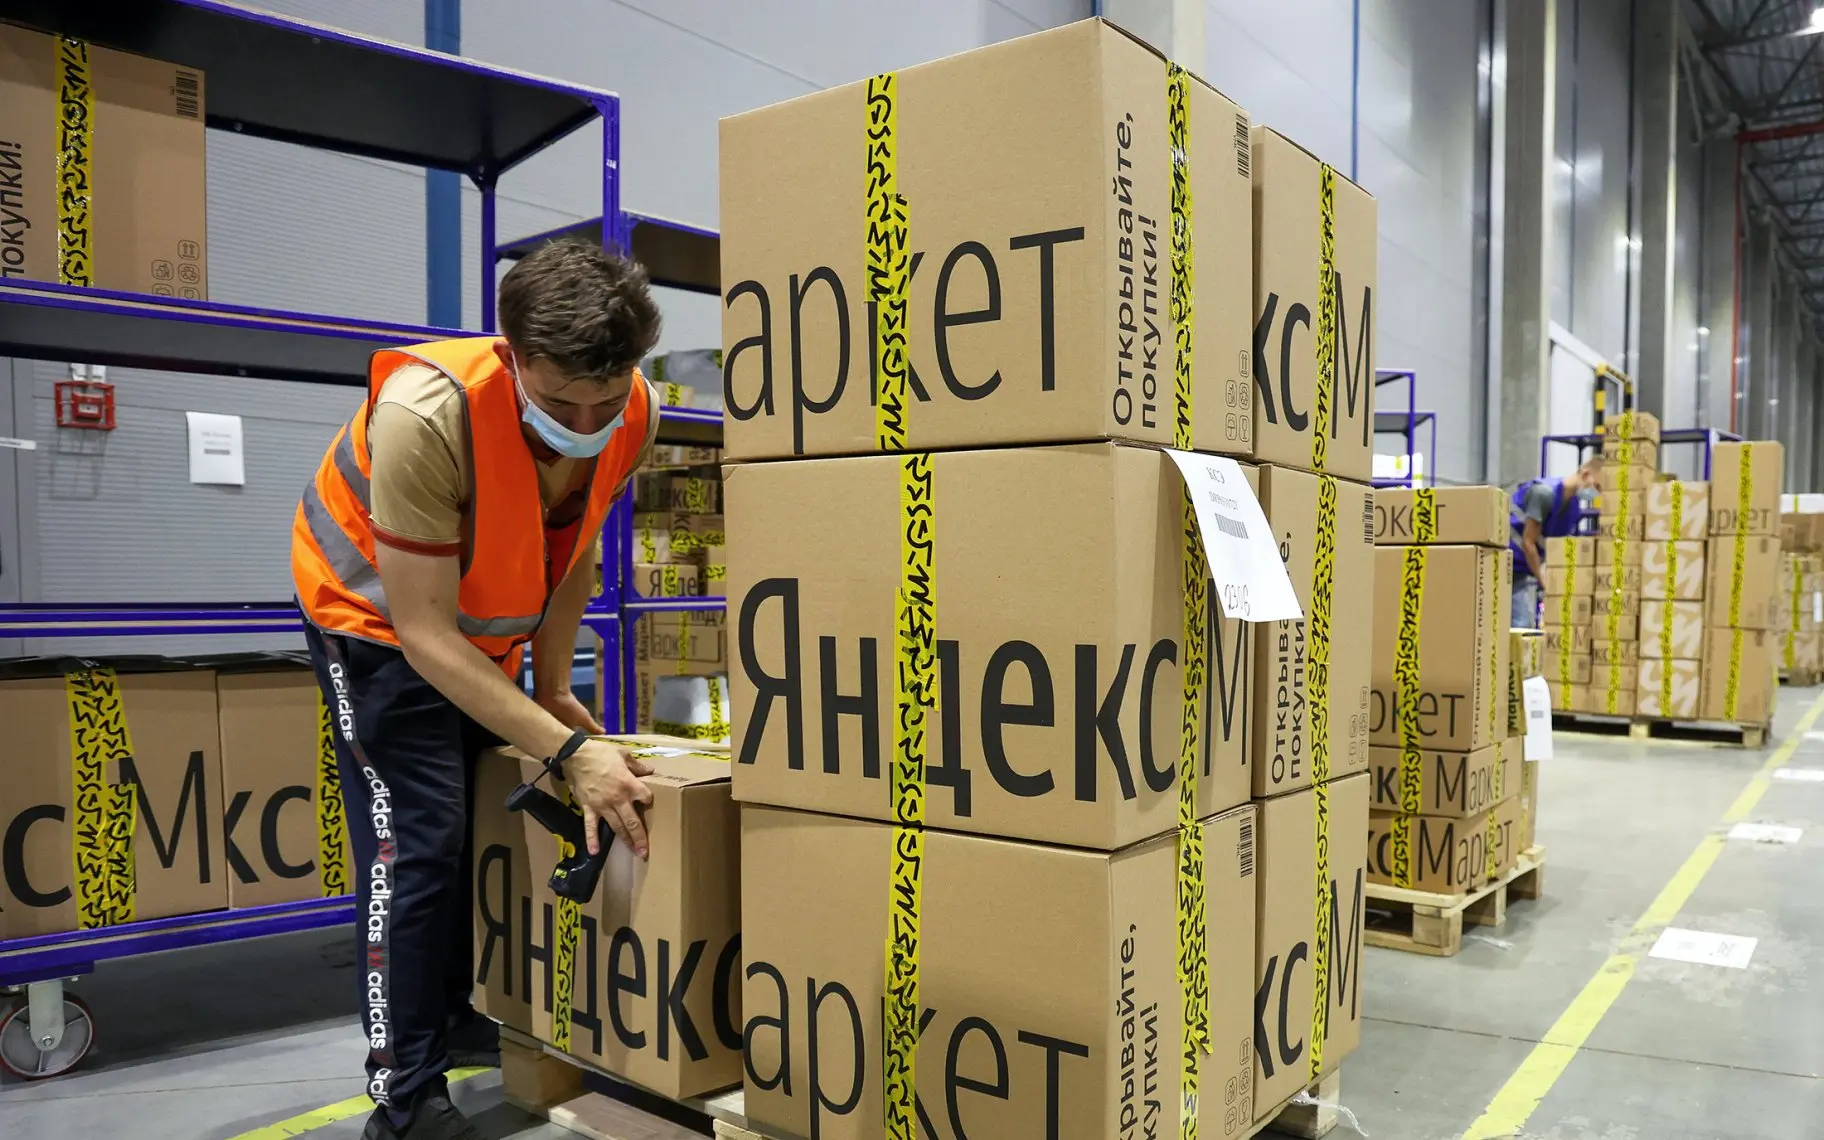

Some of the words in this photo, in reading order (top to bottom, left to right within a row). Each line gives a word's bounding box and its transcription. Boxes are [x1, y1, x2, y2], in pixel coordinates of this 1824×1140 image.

[1112, 112, 1138, 427] Открывайте,
[1138, 214, 1161, 430] покупки!
[329, 663, 353, 742] adidas
[738, 578, 1178, 818] Яндекс
[363, 766, 393, 840] adidas
[368, 863, 391, 943] adidas
[477, 843, 743, 1062] Яндекс
[368, 971, 388, 1050] adidas
